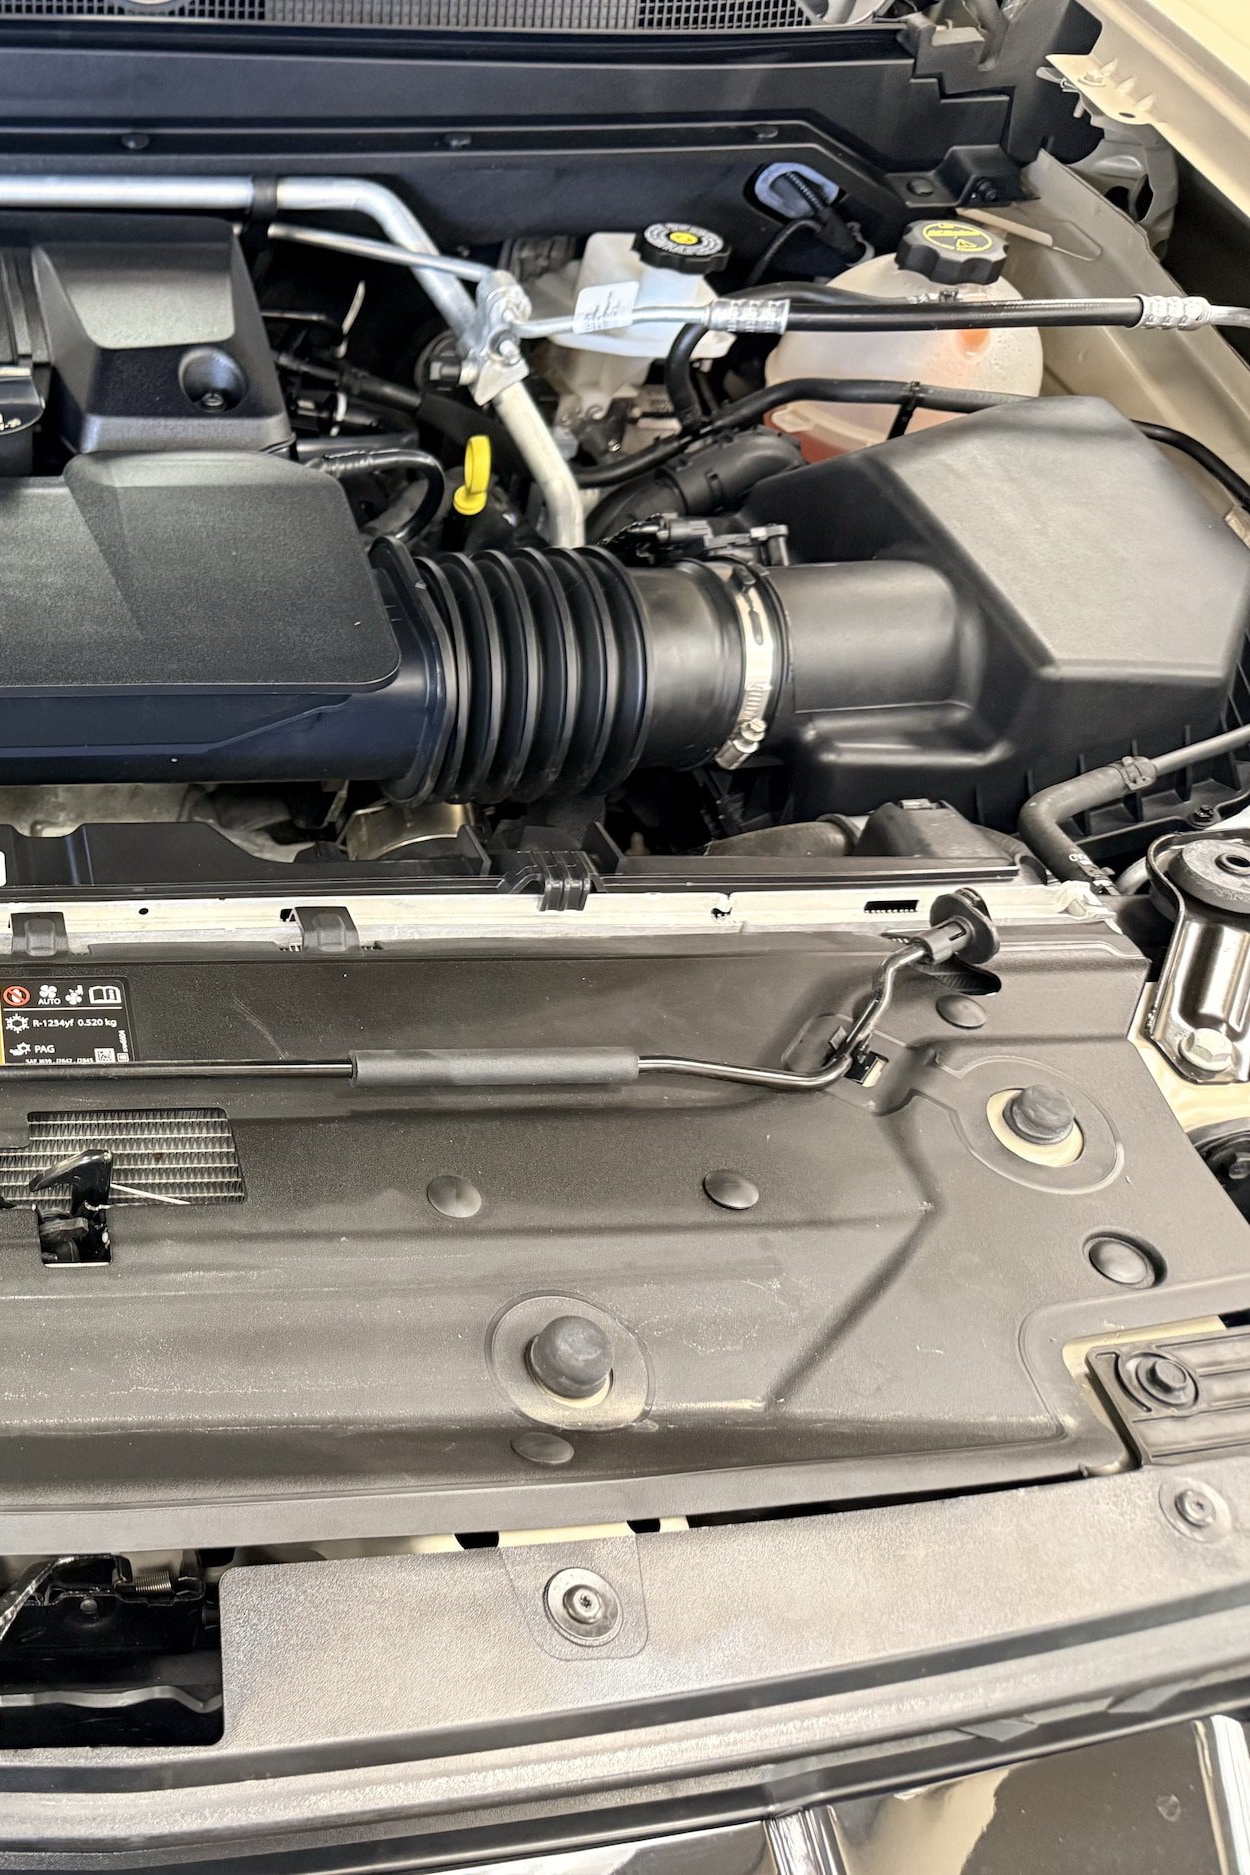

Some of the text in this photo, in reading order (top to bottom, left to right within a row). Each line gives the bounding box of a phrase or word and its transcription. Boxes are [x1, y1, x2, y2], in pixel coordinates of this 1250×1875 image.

[32, 1018, 117, 1028] R-1234yf 0.520 kg
[34, 1044, 55, 1053] PAG
